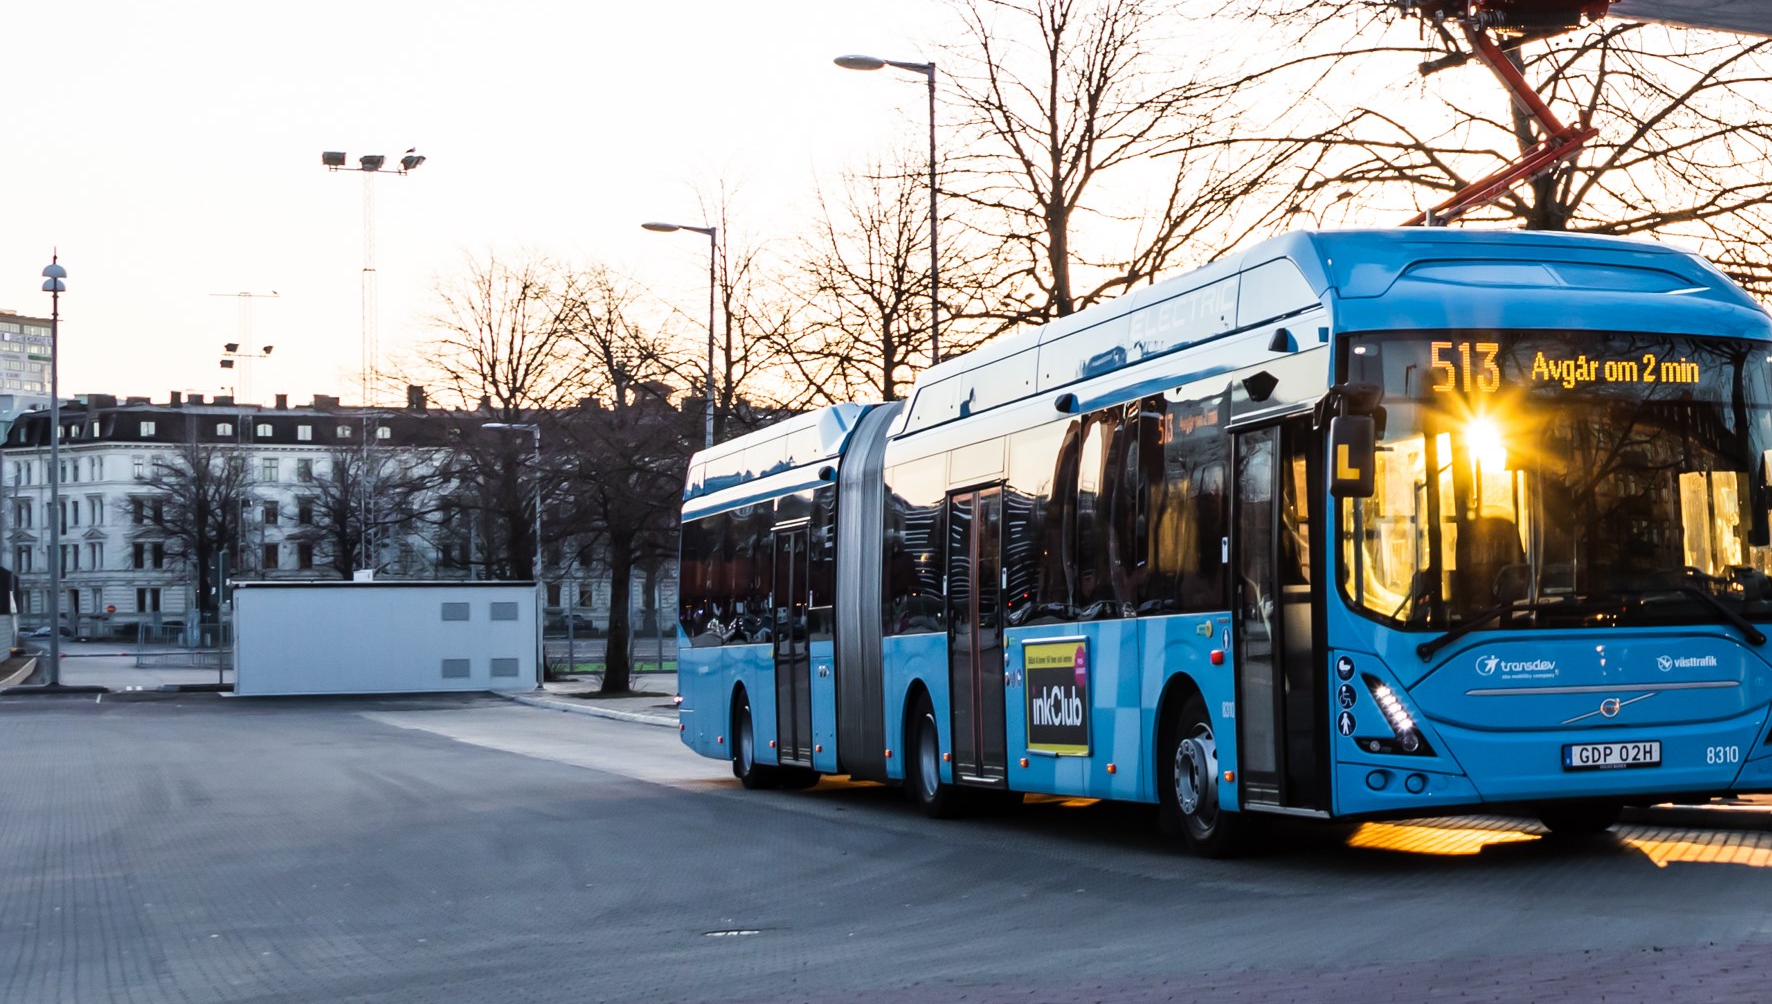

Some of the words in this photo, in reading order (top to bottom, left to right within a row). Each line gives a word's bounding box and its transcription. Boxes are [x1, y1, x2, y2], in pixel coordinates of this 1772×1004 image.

[1131, 278, 1237, 342] ELECTRIC
[1431, 341, 1500, 392] 513
[1531, 351, 1599, 388] Avgår
[1604, 360, 1638, 381] om
[1642, 354, 1656, 382] 2
[1660, 357, 1700, 383] min
[1500, 659, 1555, 671] transdev
[1674, 656, 1717, 667] västtrafik
[1032, 684, 1082, 726] inkClub
[1579, 746, 1613, 764] GDP
[1619, 744, 1653, 762] 02H
[1706, 746, 1739, 764] 8310
